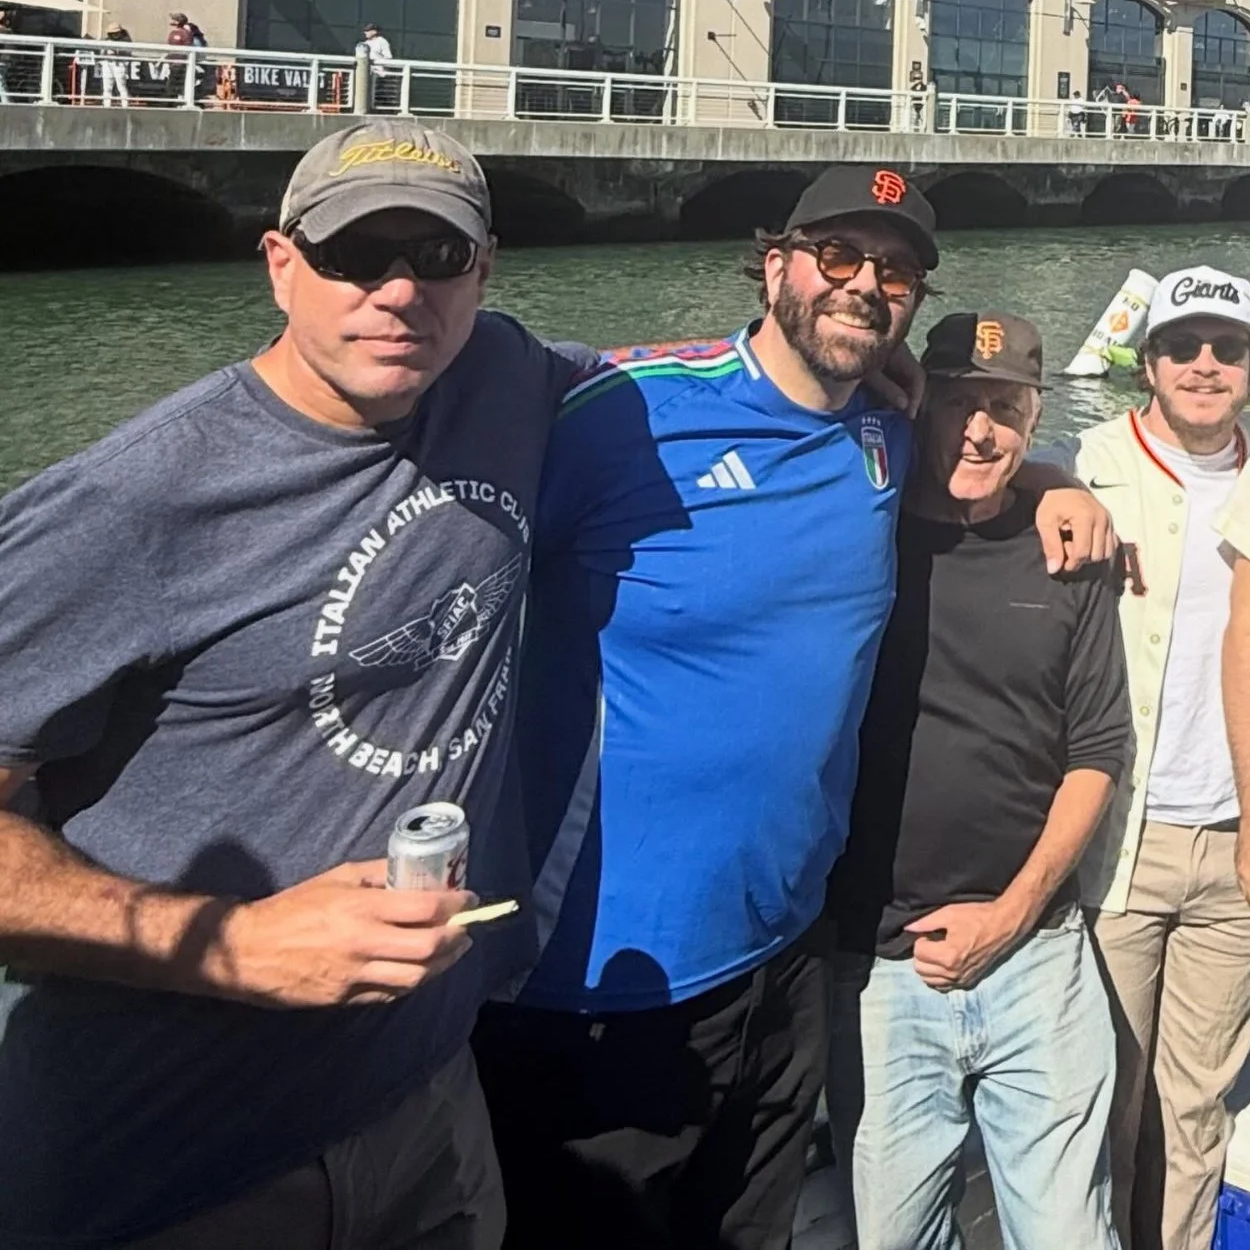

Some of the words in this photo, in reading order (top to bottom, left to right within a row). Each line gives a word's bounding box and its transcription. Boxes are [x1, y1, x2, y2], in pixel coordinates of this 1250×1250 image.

[94, 61, 140, 80] BKE
[244, 66, 279, 86] BIKE
[284, 68, 325, 89] VALT
[872, 170, 907, 204] SF
[1171, 276, 1240, 307] Giants
[976, 320, 1005, 359] SF
[311, 528, 386, 656] ITALIAN
[387, 480, 496, 536] ATHLETIC
[309, 672, 358, 755] NORTH
[349, 740, 440, 778] BEACH
[449, 712, 492, 760] SAN
